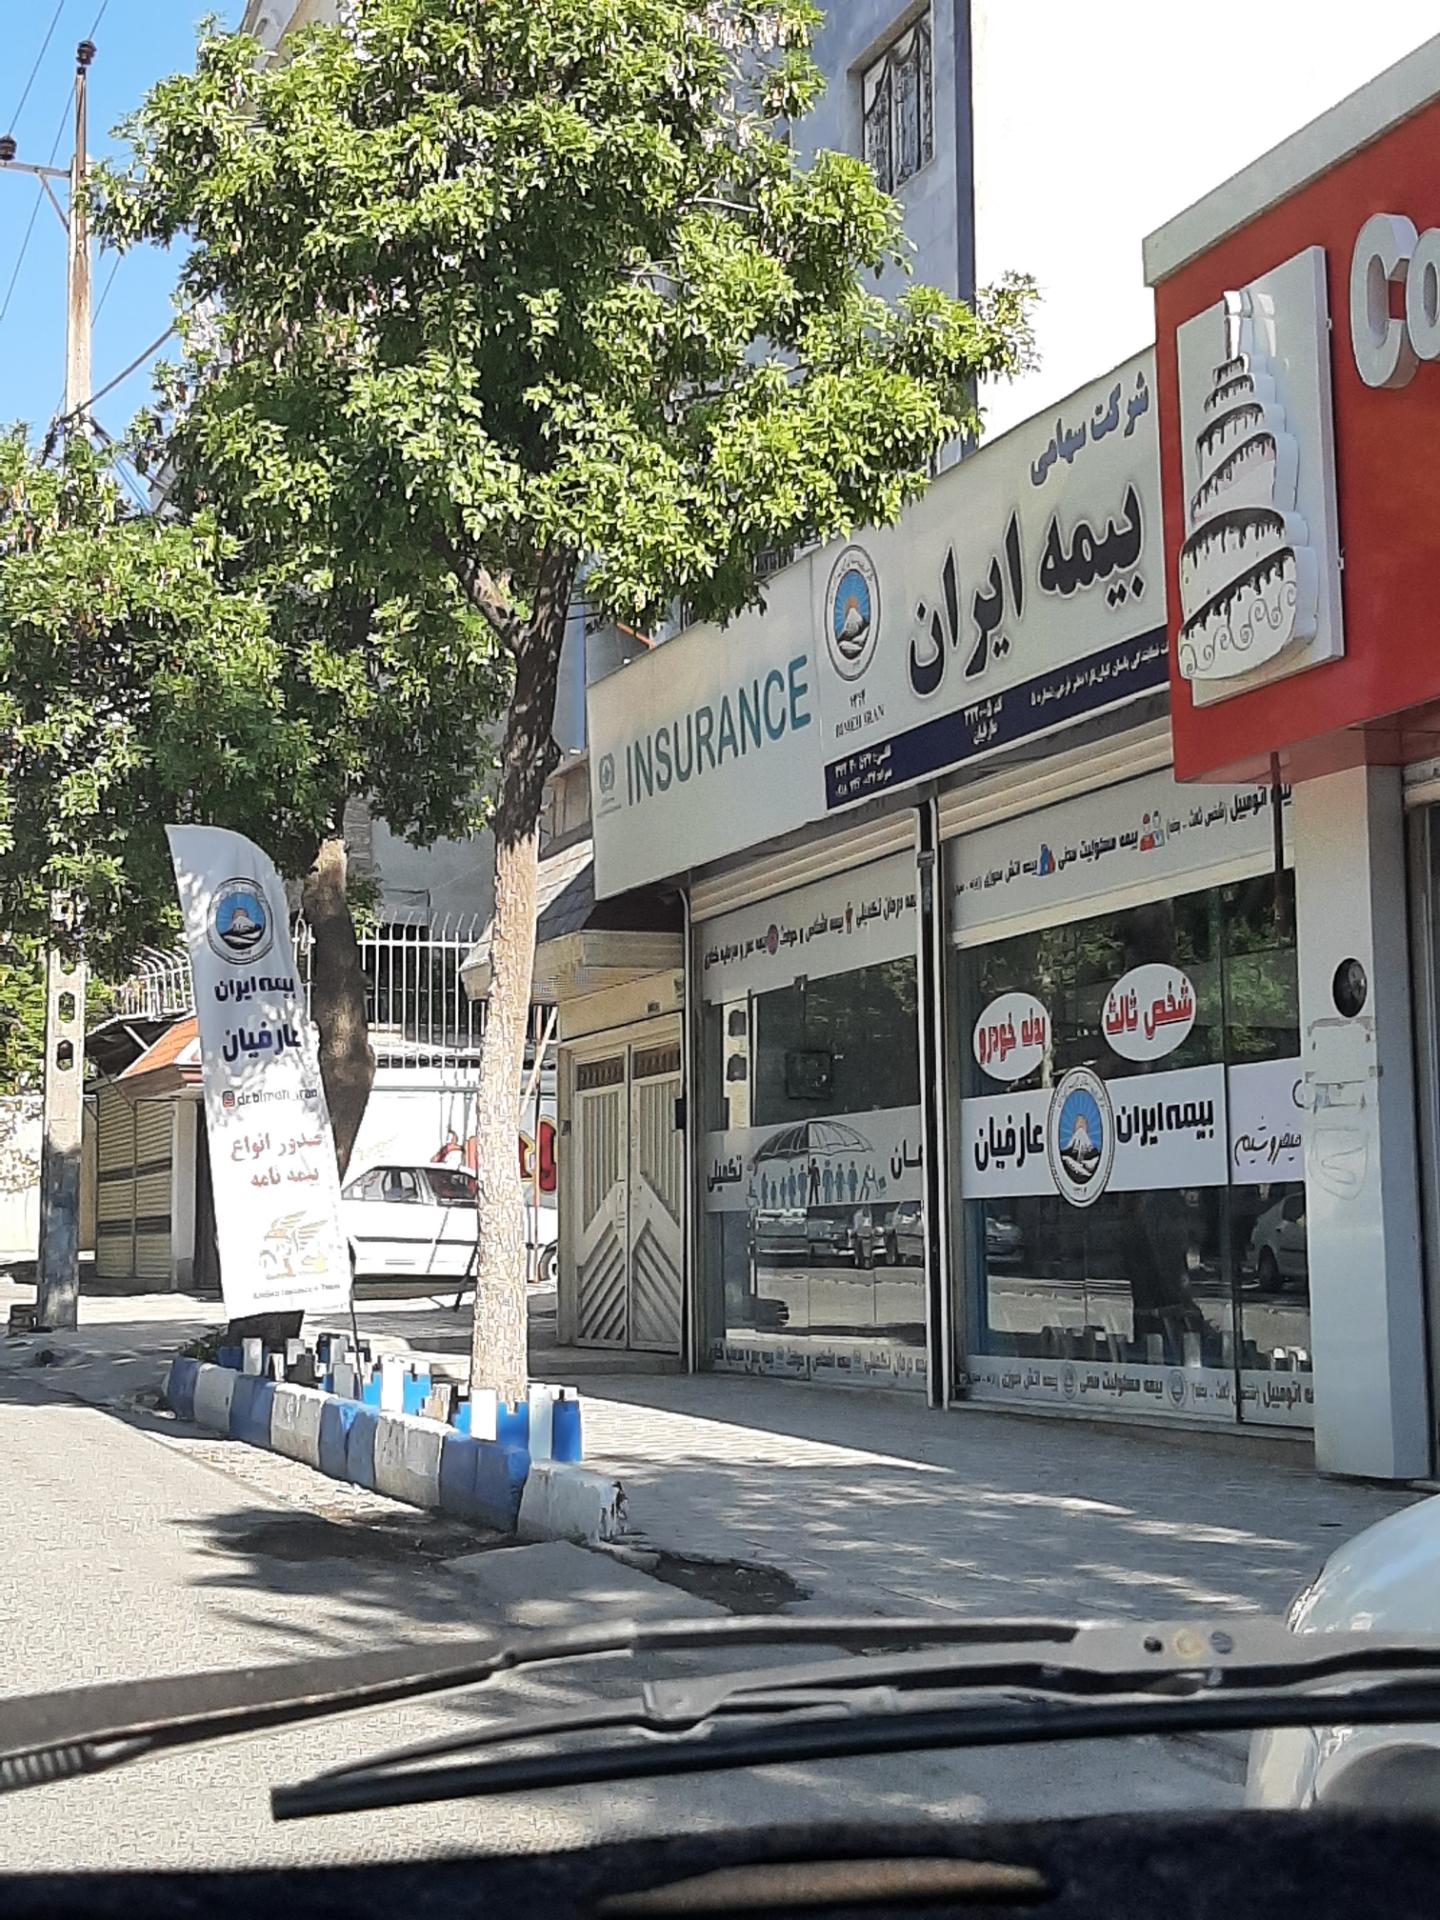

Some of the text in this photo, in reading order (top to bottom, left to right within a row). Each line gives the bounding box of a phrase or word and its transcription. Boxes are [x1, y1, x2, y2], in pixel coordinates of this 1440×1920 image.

[1031, 371, 1149, 486] شرکت سهامی
[909, 484, 1144, 696] بیمه ایران
[627, 655, 811, 806] INSURANCE
[1229, 786, 1267, 821] اتومبیل
[1119, 830, 1139, 851] بیمه
[215, 976, 296, 1002] بیمه ایران
[1106, 977, 1192, 1040] شخص ثالث
[223, 1021, 302, 1062] عارفیان
[979, 1008, 1046, 1064] بدنه خودرو
[974, 1112, 1045, 1172] عارفیان
[1116, 1100, 1214, 1146] بیمه ایران
[231, 1132, 323, 1161] صدور انواع
[707, 1155, 742, 1192] تکمیلی
[1144, 1379, 1163, 1400] بیمه
[1263, 1381, 1301, 1410] اتومبیل
